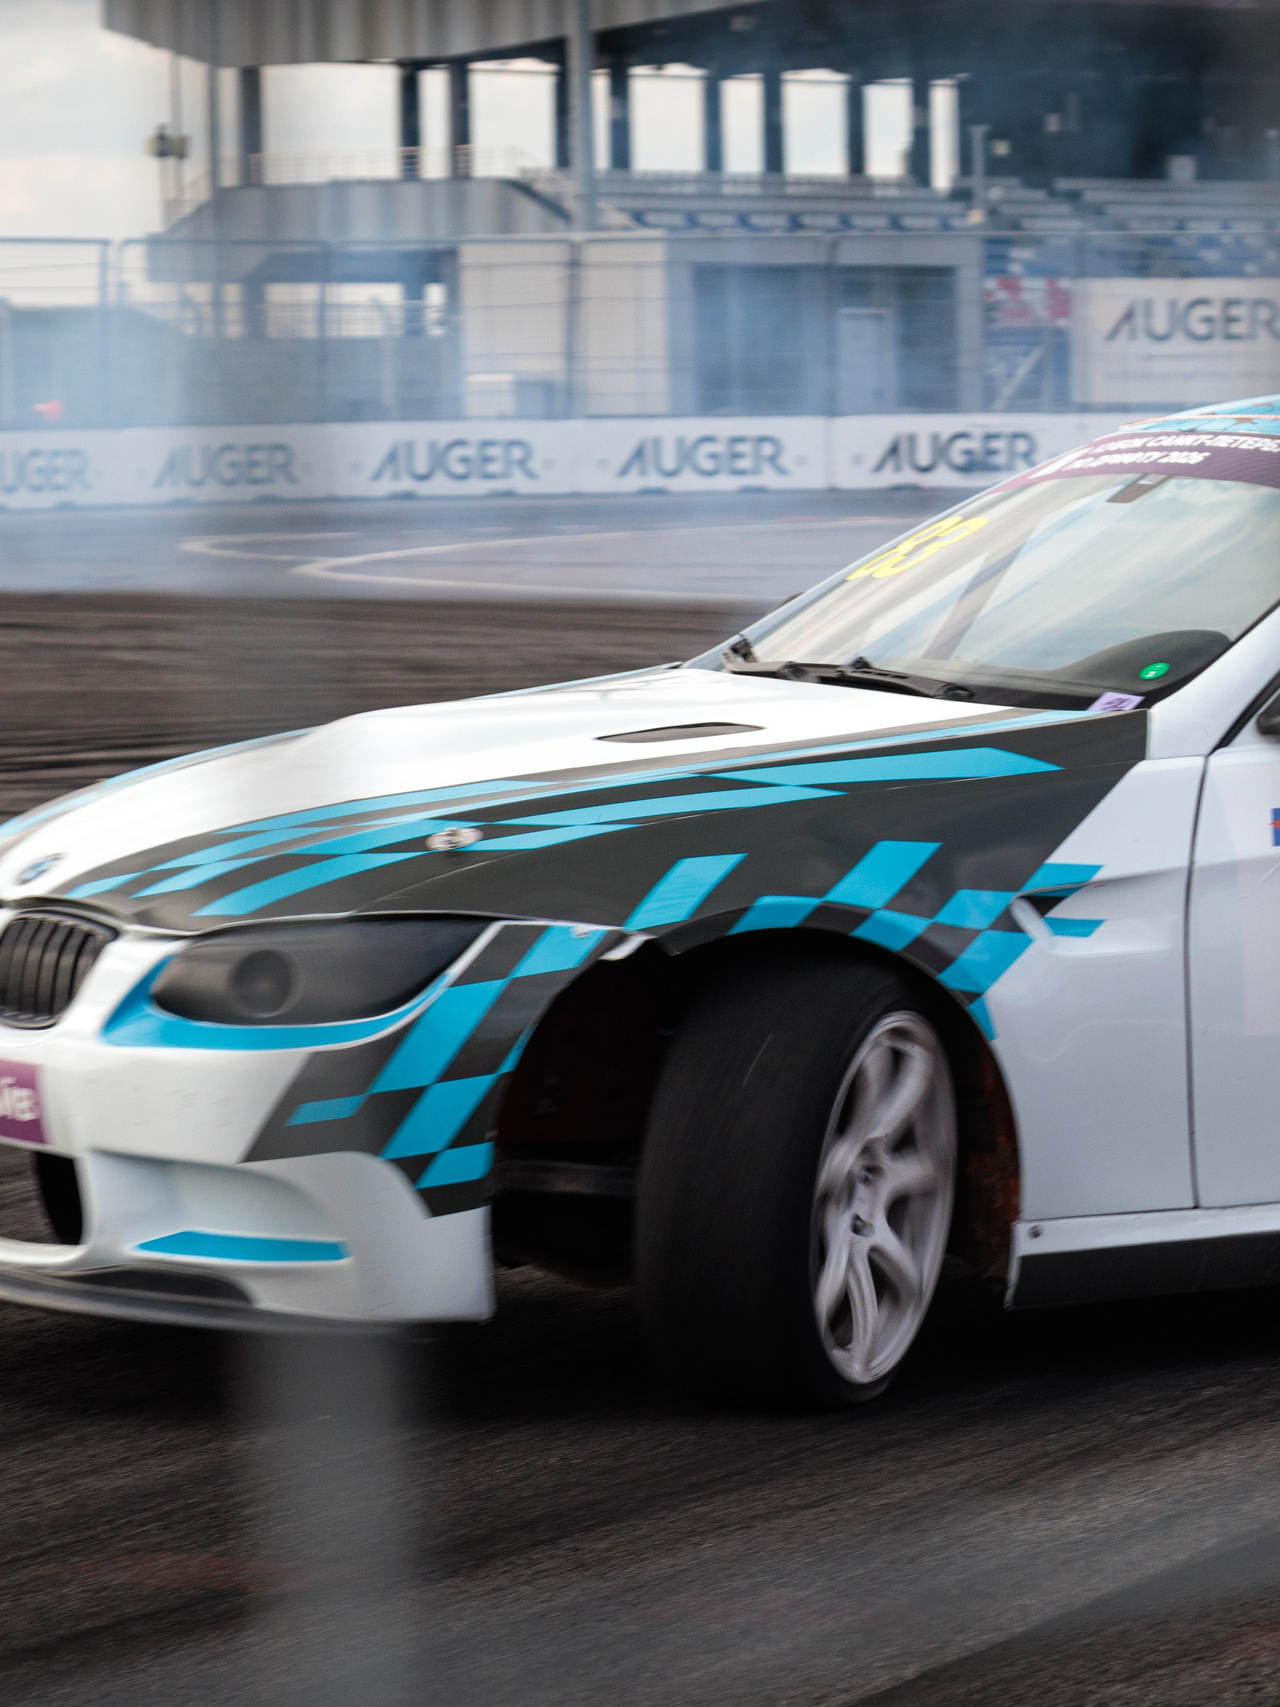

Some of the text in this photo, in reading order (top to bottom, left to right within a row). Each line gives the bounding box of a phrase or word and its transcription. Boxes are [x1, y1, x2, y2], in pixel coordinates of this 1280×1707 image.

[154, 443, 300, 488] AUGER
[370, 438, 540, 482] AUGER
[616, 435, 789, 478] AUGER
[871, 431, 1038, 475] AUGER
